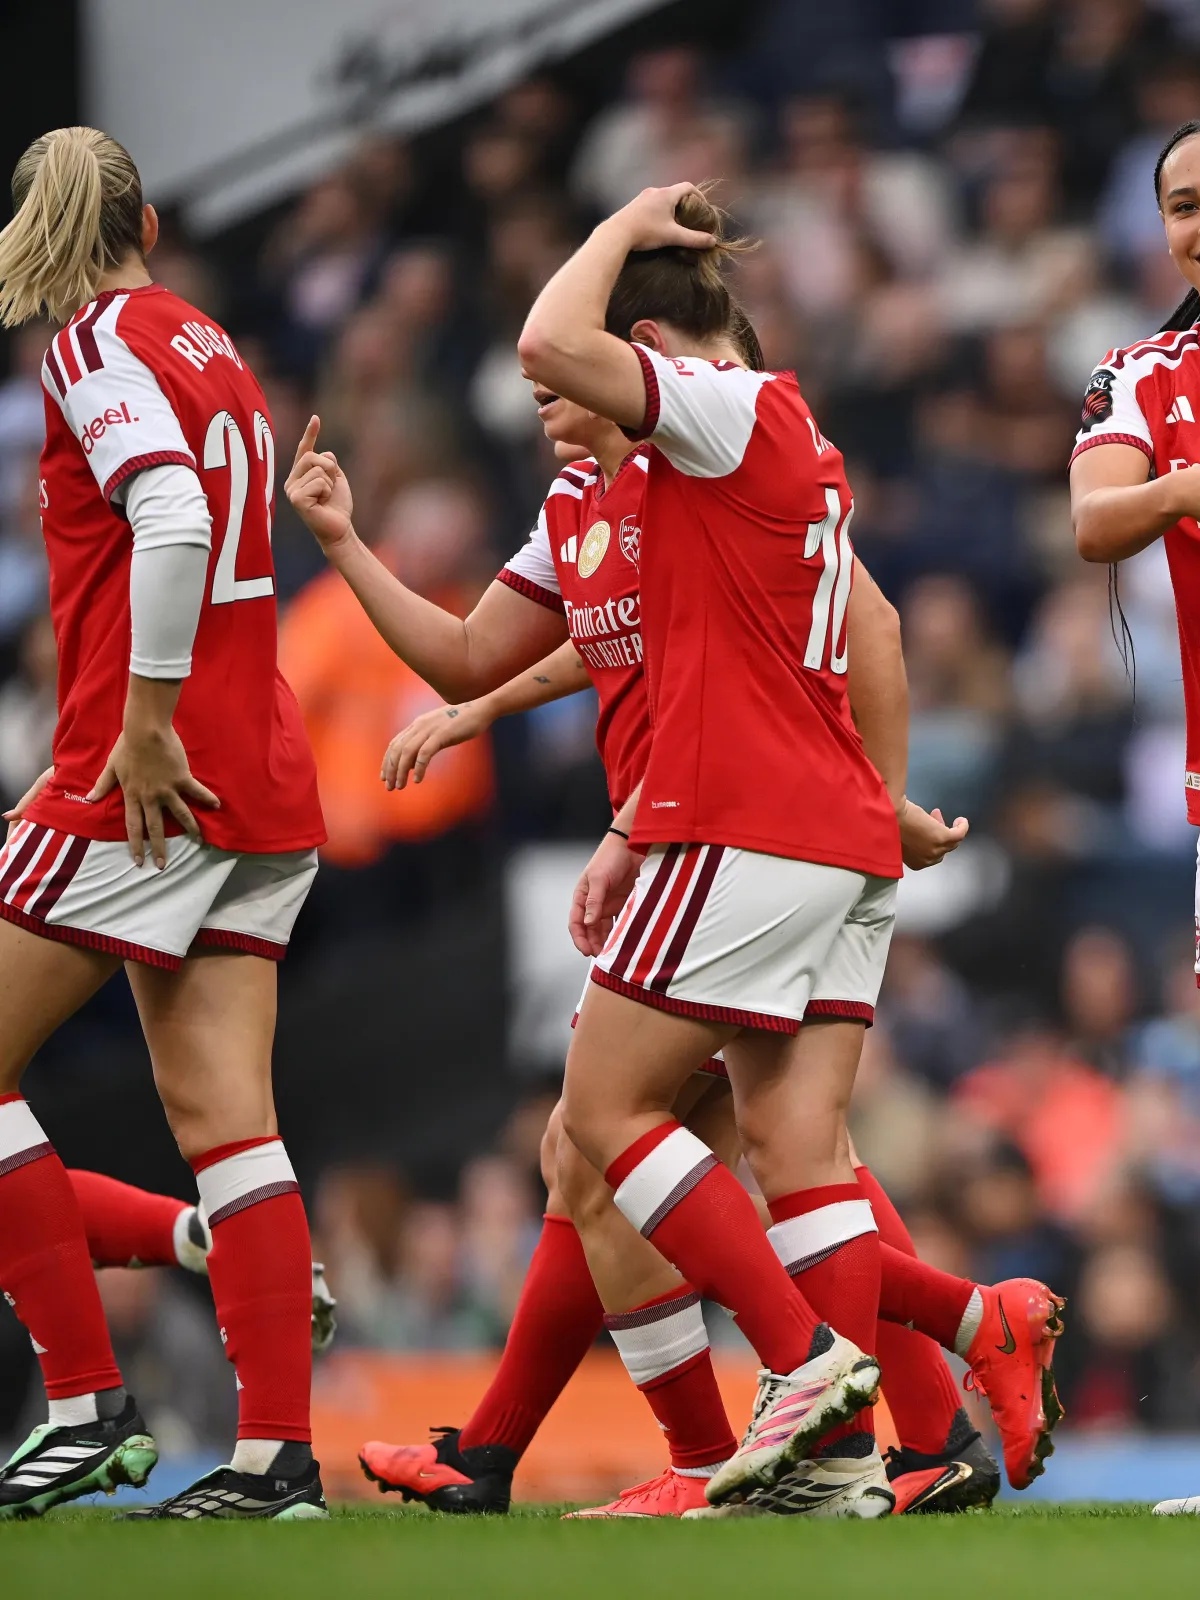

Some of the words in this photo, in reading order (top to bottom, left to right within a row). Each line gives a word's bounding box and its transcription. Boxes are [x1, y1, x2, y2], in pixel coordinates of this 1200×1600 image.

[170, 321, 243, 372] RUSSO
[81, 401, 140, 455] deel.
[563, 593, 641, 638] Emirate
